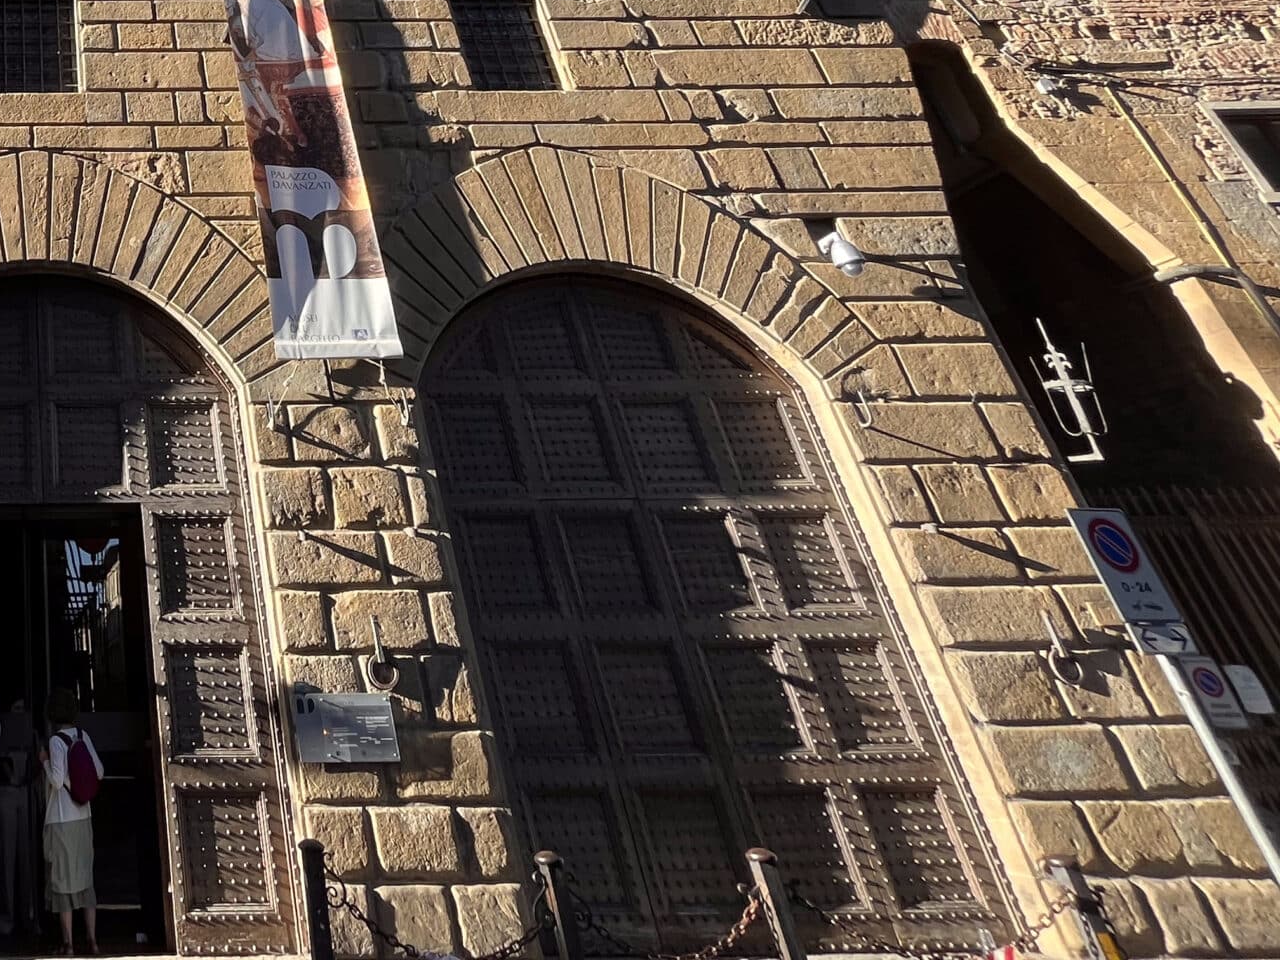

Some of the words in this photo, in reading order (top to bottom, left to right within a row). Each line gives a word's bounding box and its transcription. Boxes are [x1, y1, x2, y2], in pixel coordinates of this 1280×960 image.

[270, 170, 317, 180] PALAZZO
[272, 180, 331, 190] DAVANZATI
[1121, 582, 1152, 593] 0-24
